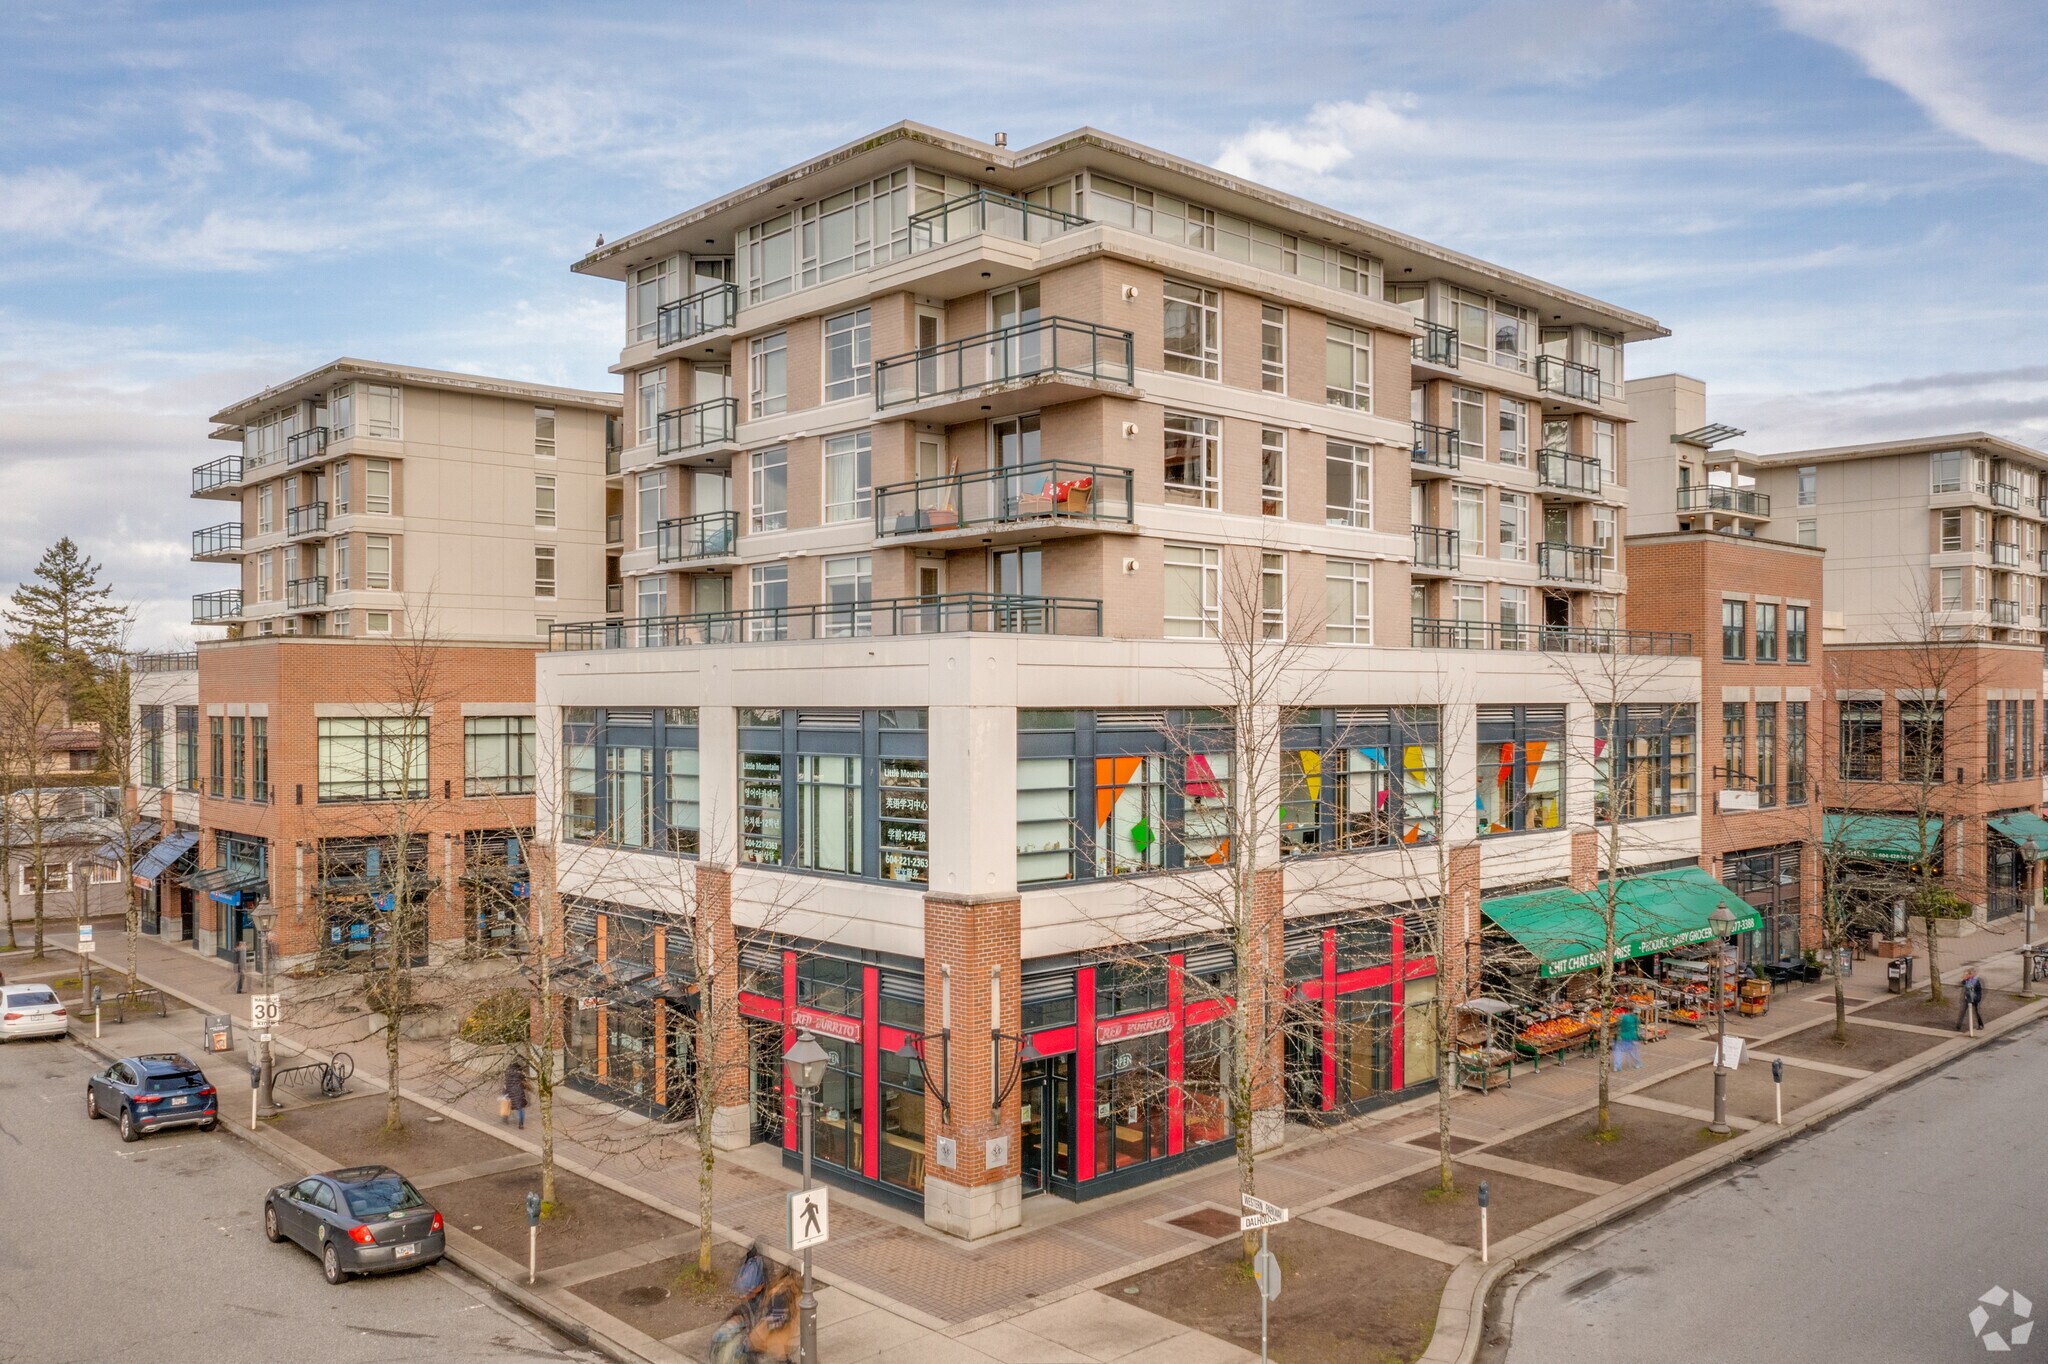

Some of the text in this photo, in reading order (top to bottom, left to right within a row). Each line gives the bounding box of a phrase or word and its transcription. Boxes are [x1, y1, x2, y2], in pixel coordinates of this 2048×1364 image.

[743, 762, 780, 771] Little Mountain
[884, 769, 929, 779] Little Mountain
[886, 798, 928, 811] 英语学习中心
[1548, 960, 1568, 975] CHIT
[1568, 954, 1588, 970] CHAT
[255, 1004, 277, 1020] 30
[815, 1017, 855, 1037] BURRITO
[1102, 1015, 1171, 1039] RED BURRITO
